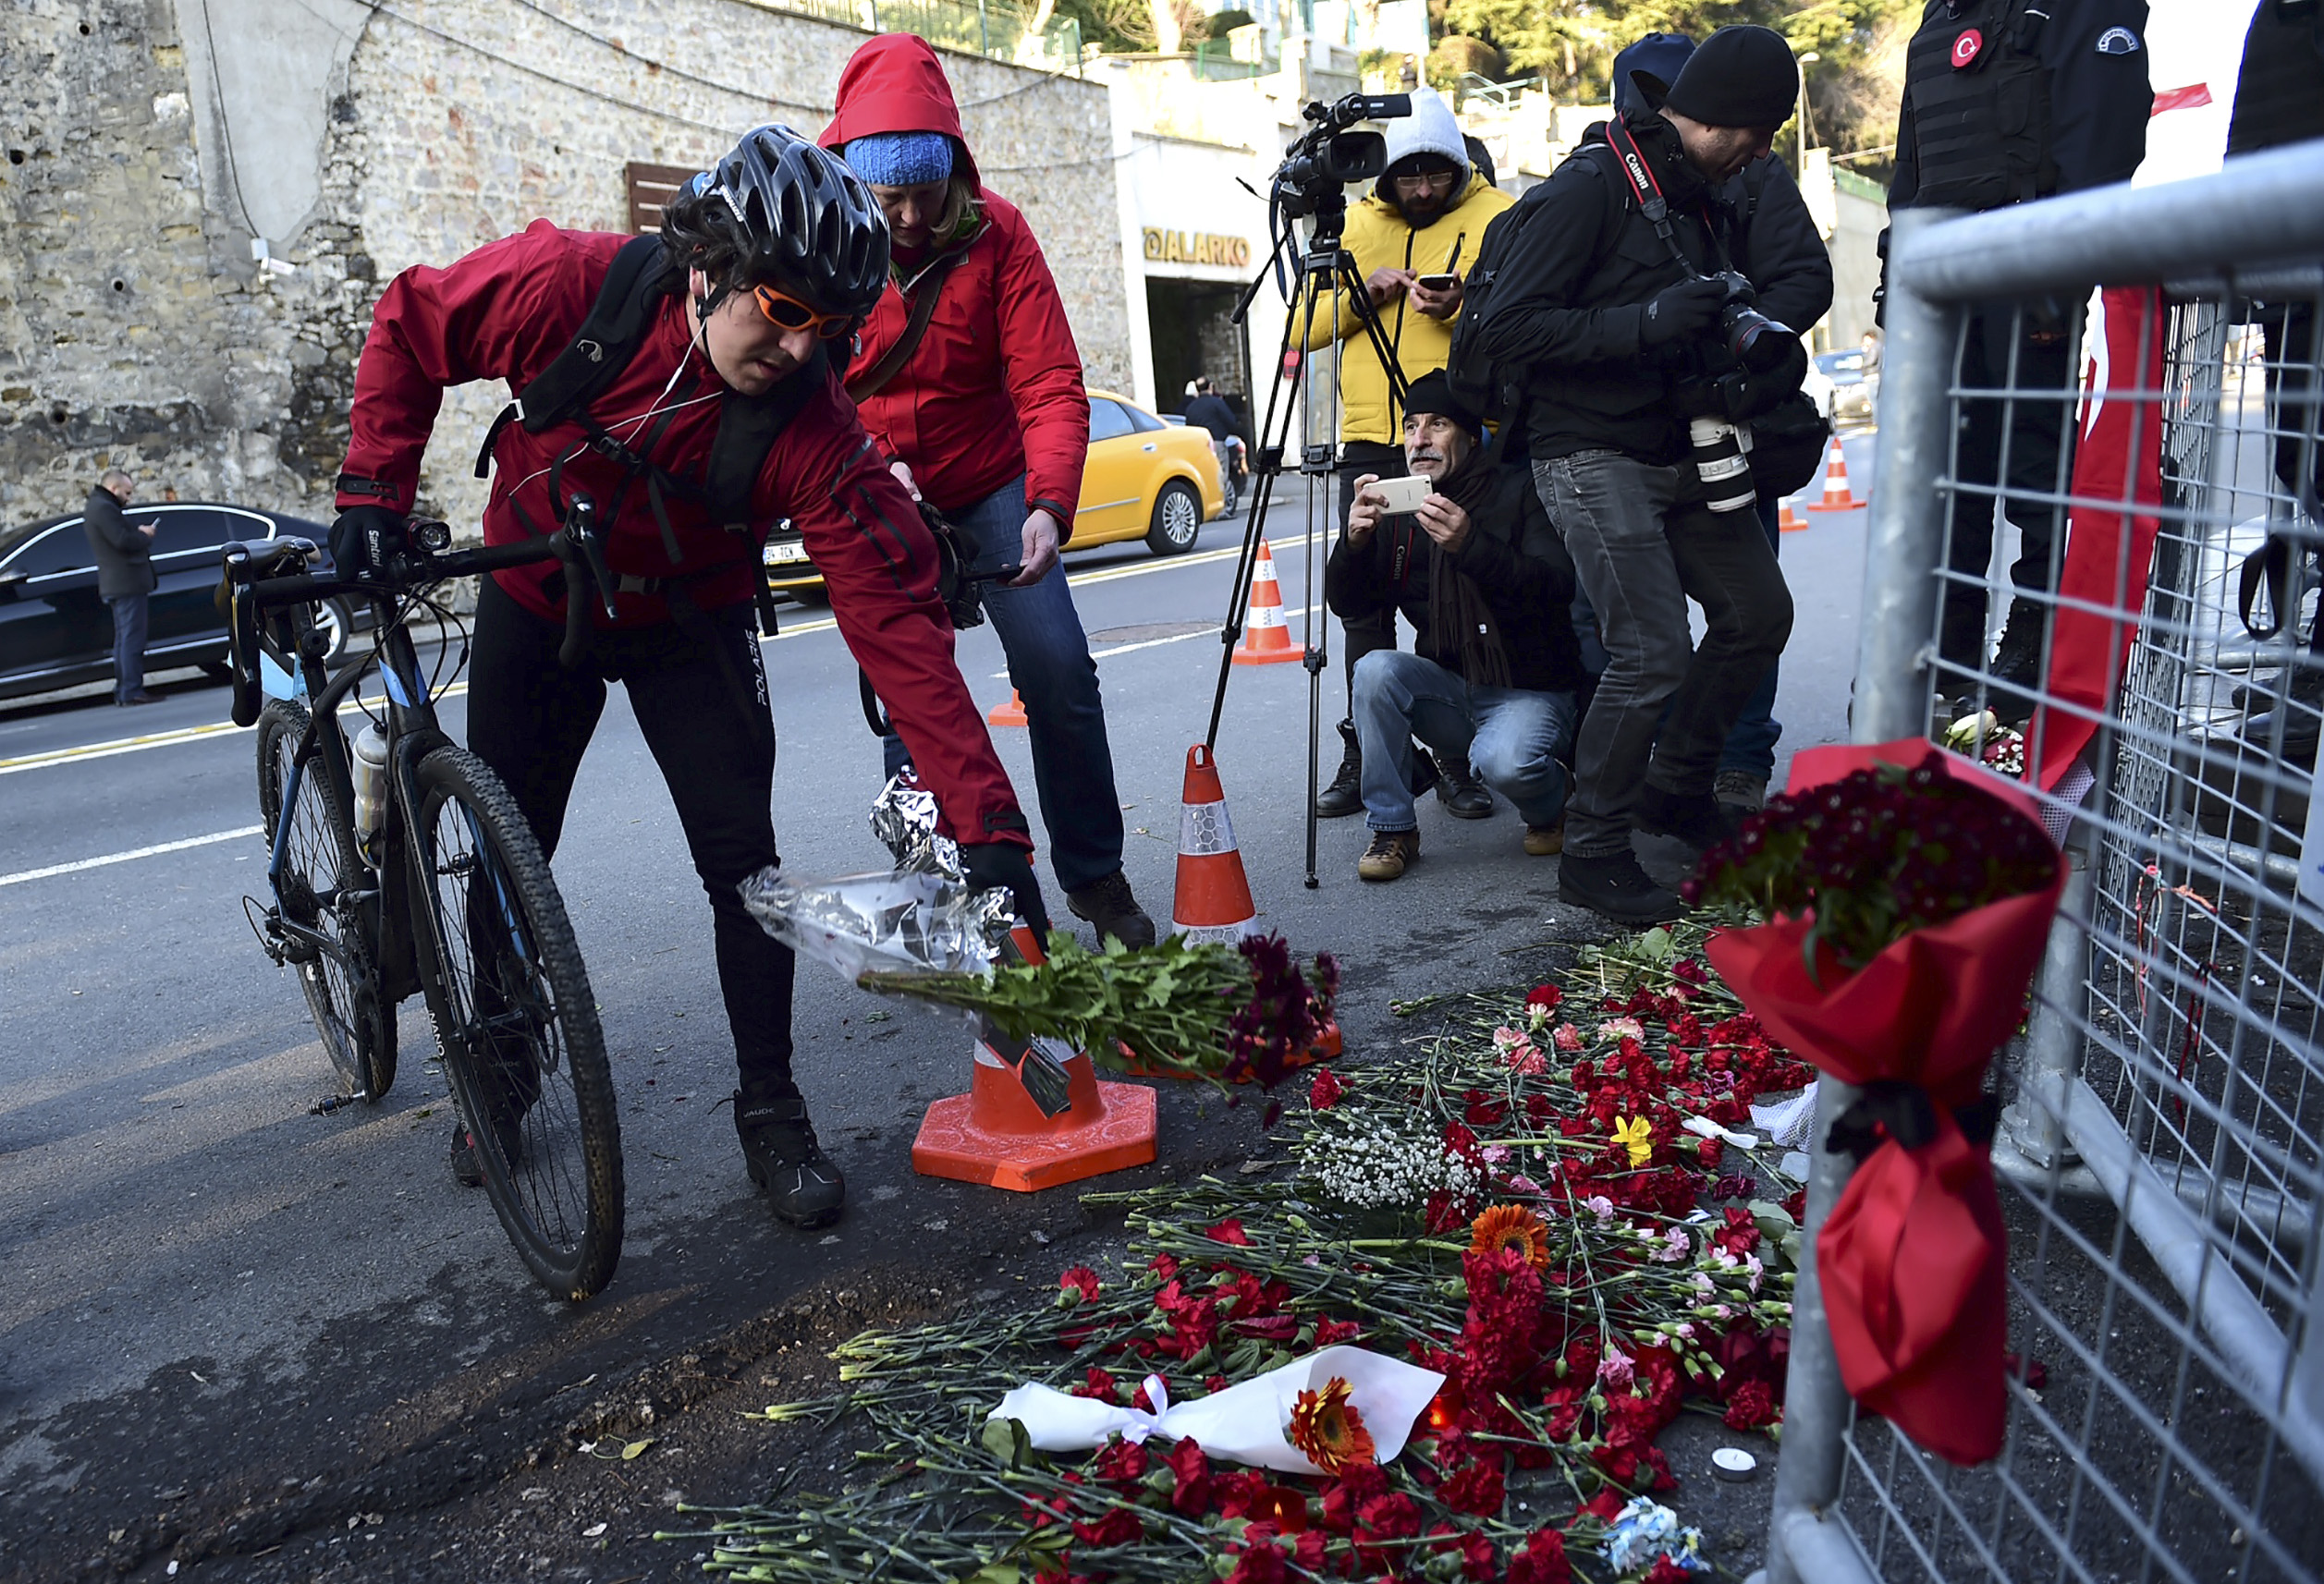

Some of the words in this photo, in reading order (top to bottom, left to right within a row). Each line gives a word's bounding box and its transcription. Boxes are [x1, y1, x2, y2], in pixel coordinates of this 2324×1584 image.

[1625, 152, 1649, 189] Canon
[1165, 228, 1251, 267] ALARKO
[369, 530, 384, 567] Santini
[1393, 545, 1405, 580] Canon
[744, 628, 767, 706] POLARIS
[428, 1012, 446, 1056] NANO
